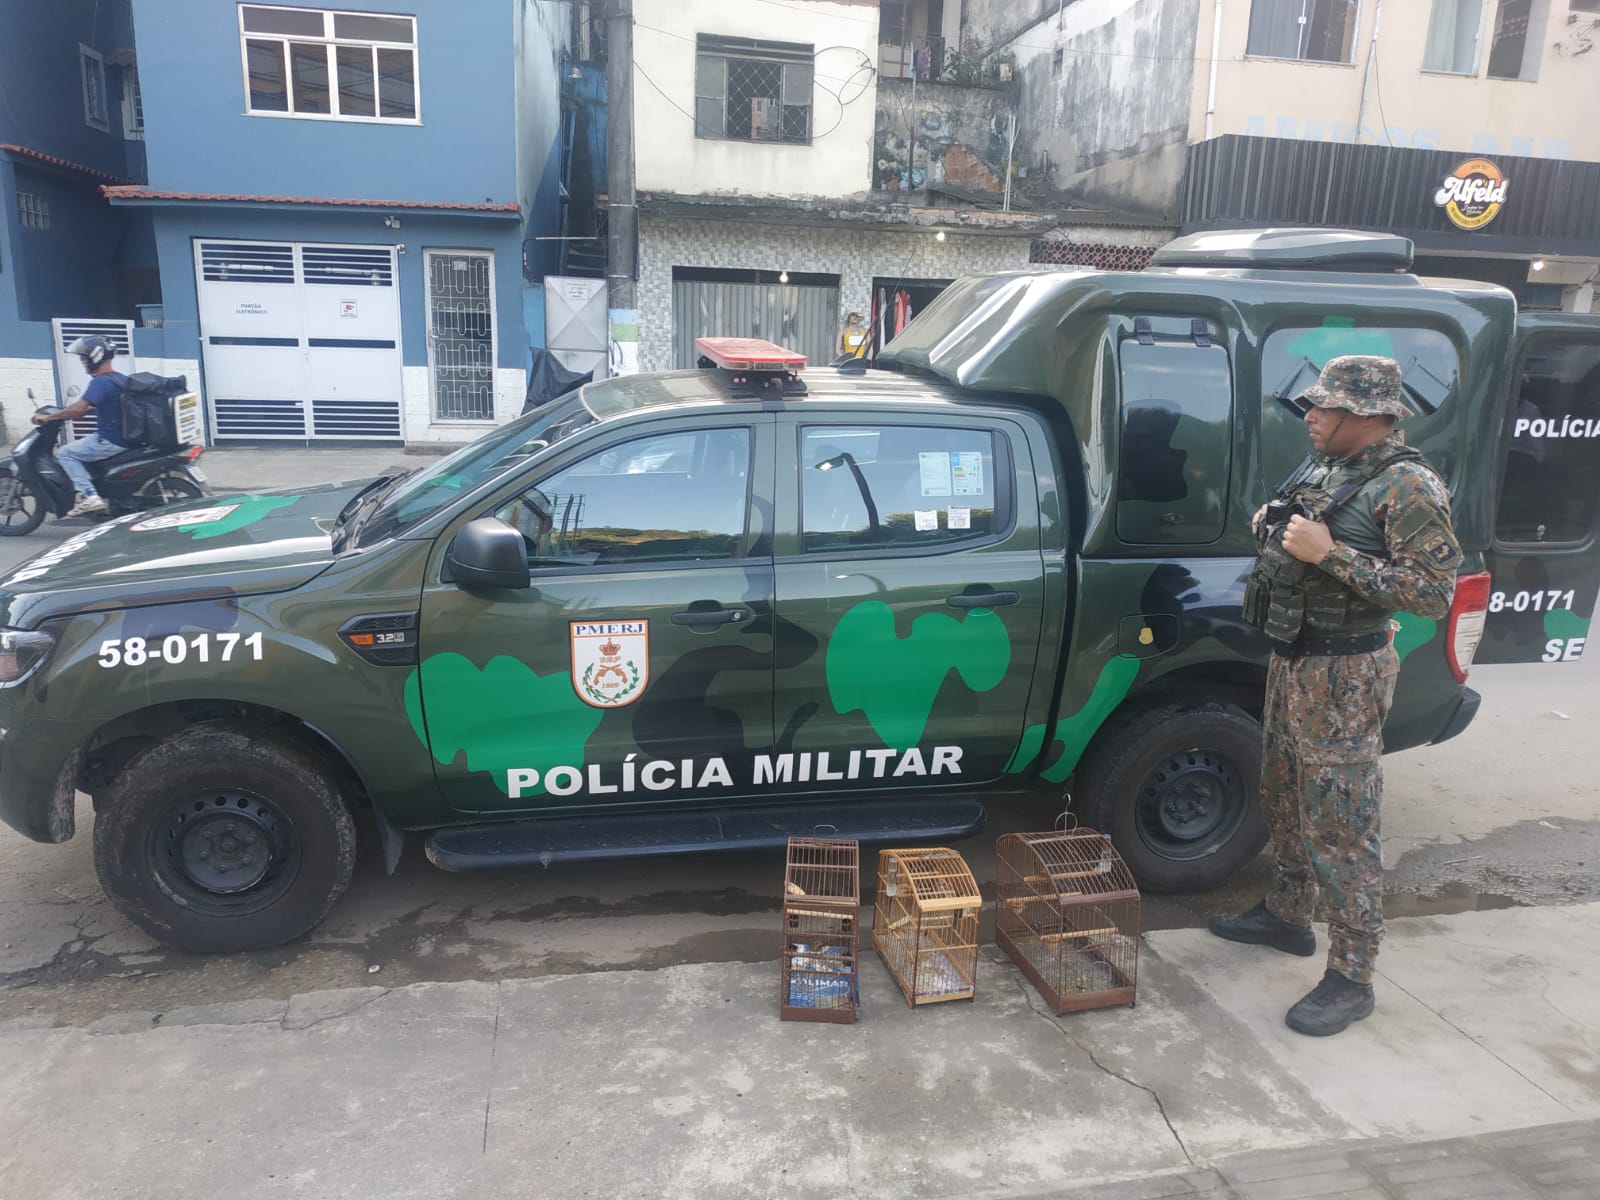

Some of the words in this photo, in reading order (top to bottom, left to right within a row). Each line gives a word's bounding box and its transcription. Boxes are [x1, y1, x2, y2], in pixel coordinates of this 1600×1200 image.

[1434, 176, 1508, 206] Alfeld
[575, 623, 643, 635] PMERJ
[97, 631, 264, 669] 58-0171
[506, 752, 735, 799] POLÍCIA
[753, 745, 965, 785] MILITAR
